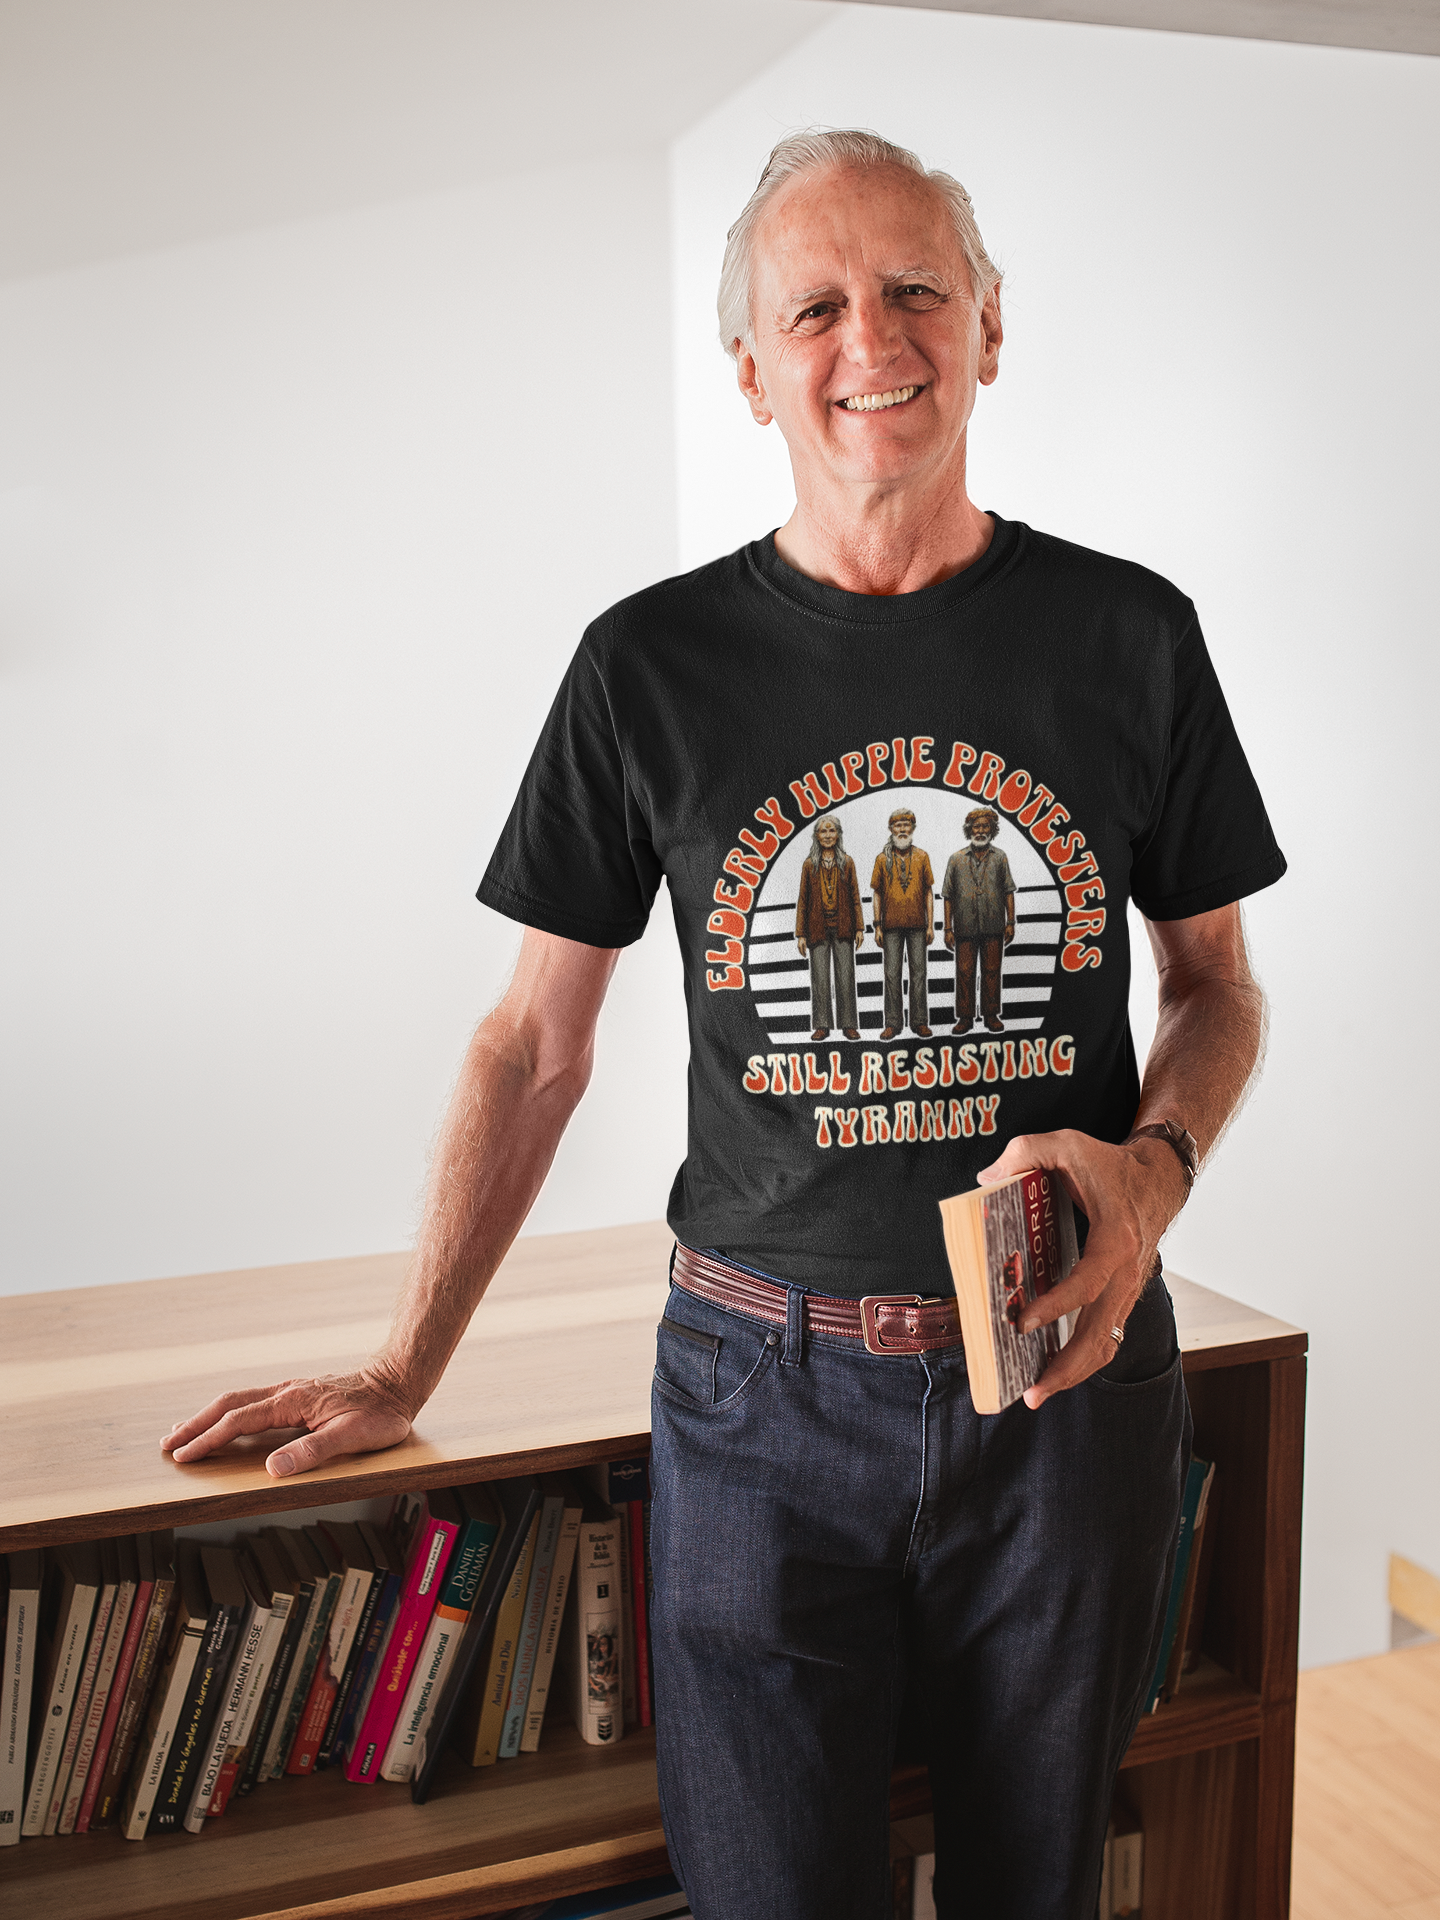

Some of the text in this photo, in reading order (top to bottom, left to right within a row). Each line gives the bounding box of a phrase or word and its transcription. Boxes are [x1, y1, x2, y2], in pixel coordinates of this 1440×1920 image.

[706, 736, 1106, 992] ELDERLY HIPPIE PROTESTERS
[743, 1035, 1076, 1095] STILL RESISTING
[814, 1094, 1000, 1148] TYRANNY
[1028, 1181, 1045, 1278] DORIS
[1041, 1175, 1059, 1282] ESSING
[451, 1546, 477, 1588] DANIEL
[459, 1542, 489, 1602] GOLEMAN
[513, 1565, 549, 1706] DIOS NUNCA PARPADEA
[545, 1575, 565, 1653] HISTORIA DE CRISTO
[244, 1624, 263, 1660] HESSE
[195, 1667, 213, 1705] duermen
[228, 1661, 251, 1712] HERMANN
[387, 1647, 409, 1692] Quiúbole
[403, 1633, 450, 1747] La inteligencia emocional
[491, 1638, 512, 1707] Amistad con Dios
[9, 1714, 17, 1743] ARMANDO
[75, 1738, 95, 1779] DIEGO
[88, 1690, 106, 1728] FRIDA
[193, 1708, 201, 1720] no
[214, 1718, 233, 1753] RUEDA
[149, 1775, 156, 1786] LA
[175, 1759, 188, 1772] los
[201, 1769, 217, 1797] BAJO
[210, 1754, 223, 1768] LA
[168, 1775, 183, 1803] Donde
